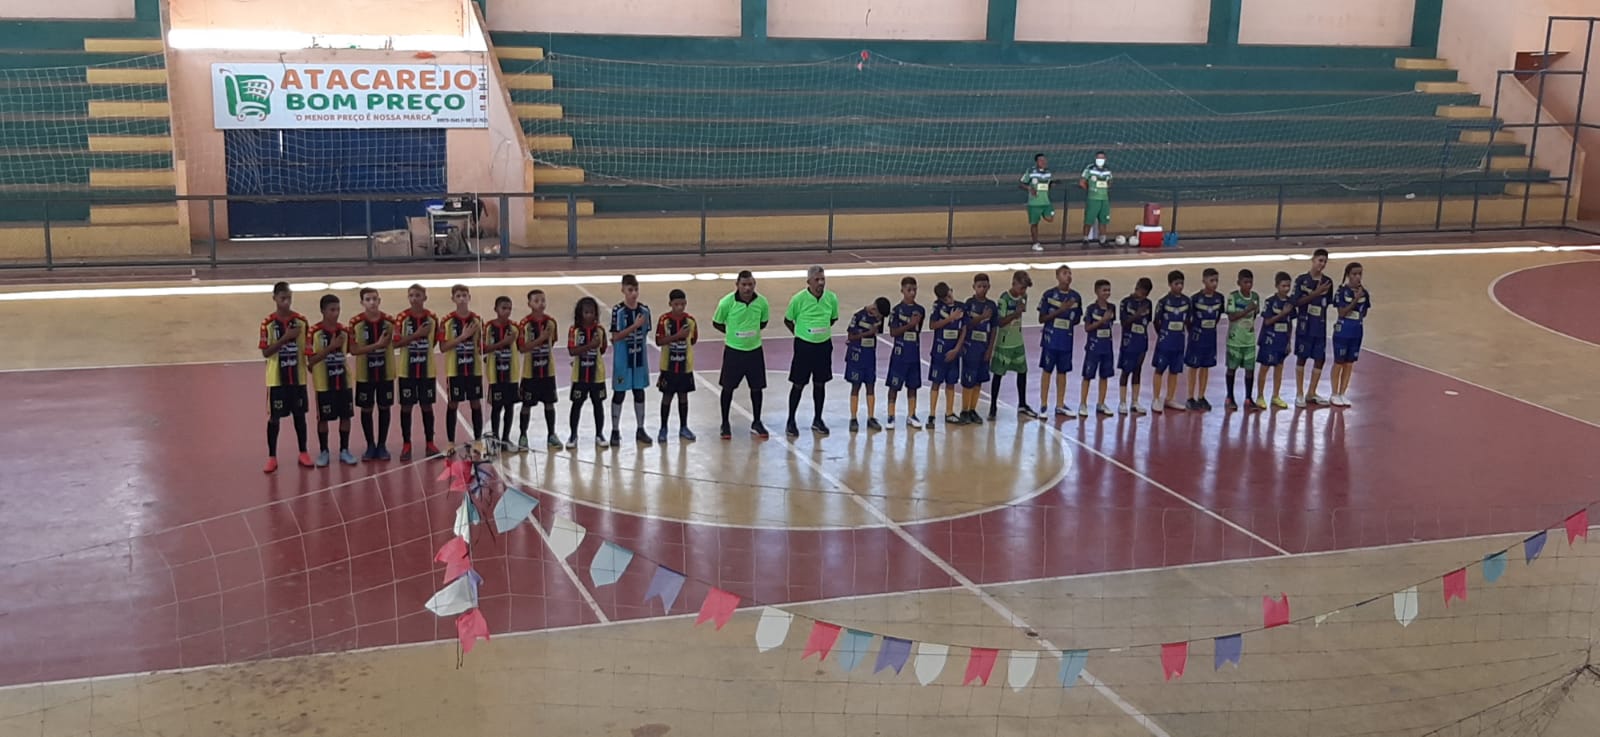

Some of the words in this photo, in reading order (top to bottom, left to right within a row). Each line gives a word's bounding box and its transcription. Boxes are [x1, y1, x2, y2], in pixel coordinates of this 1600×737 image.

[280, 69, 478, 91] ATACAREJO
[286, 93, 357, 110] BOM
[367, 93, 466, 115] PREÇO
[337, 114, 365, 122] PREÇO
[366, 112, 371, 121] É
